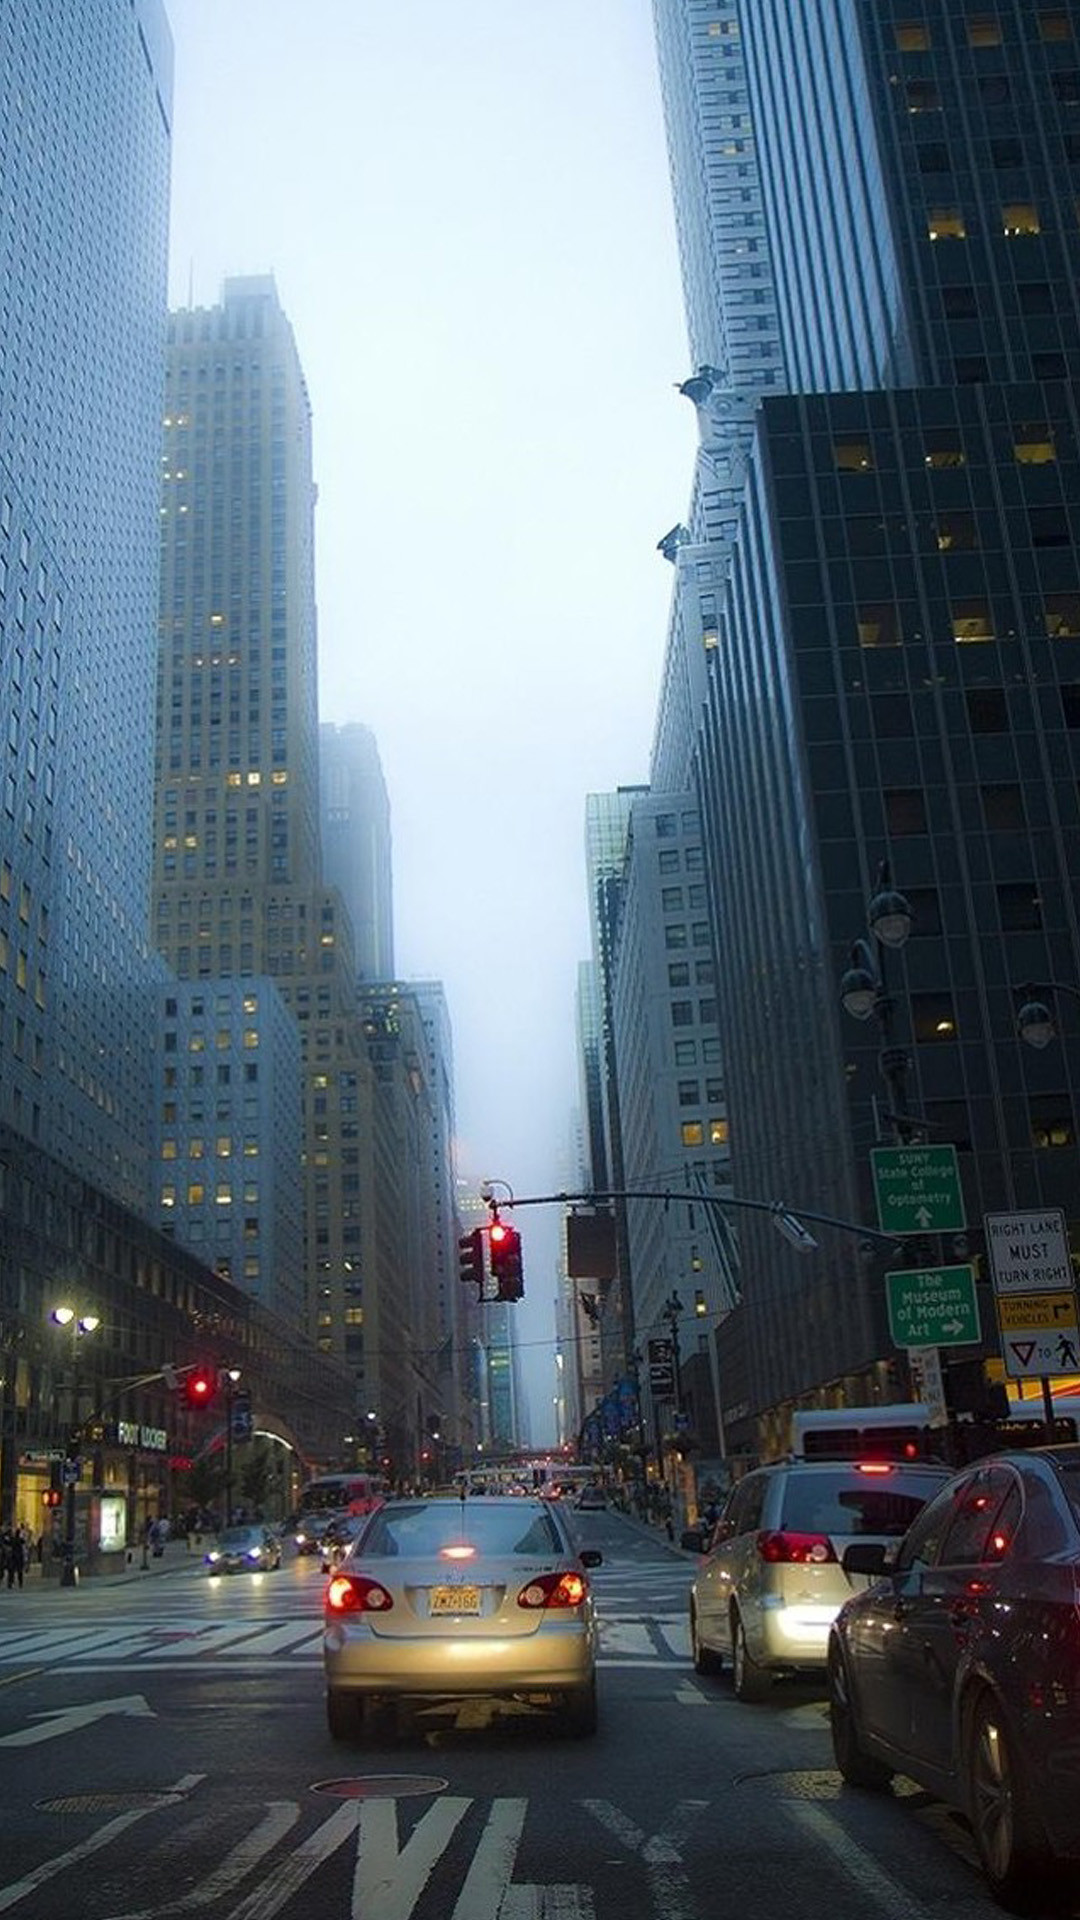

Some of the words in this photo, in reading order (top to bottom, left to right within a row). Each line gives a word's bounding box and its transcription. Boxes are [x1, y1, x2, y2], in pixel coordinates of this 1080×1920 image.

[899, 1153, 932, 1165] SUNY
[878, 1167, 908, 1179] State
[911, 1165, 954, 1178] College
[911, 1178, 925, 1190] of
[888, 1193, 951, 1207] Optometry
[991, 1222, 1025, 1238] RIGHT
[1030, 1219, 1060, 1235] LANE
[1009, 1243, 1048, 1260] MUST
[917, 1274, 943, 1288] The
[999, 1266, 1029, 1283] TURN
[1032, 1266, 1067, 1281] RIGHT
[902, 1288, 962, 1305] Museum
[897, 1305, 912, 1321] of
[916, 1302, 971, 1319] Modern
[907, 1323, 930, 1337] Art
[1038, 1346, 1052, 1359] TO
[118, 1421, 139, 1445] FOOT
[141, 1425, 167, 1450] LOCKER
[100, 1797, 710, 1920] ONLY
